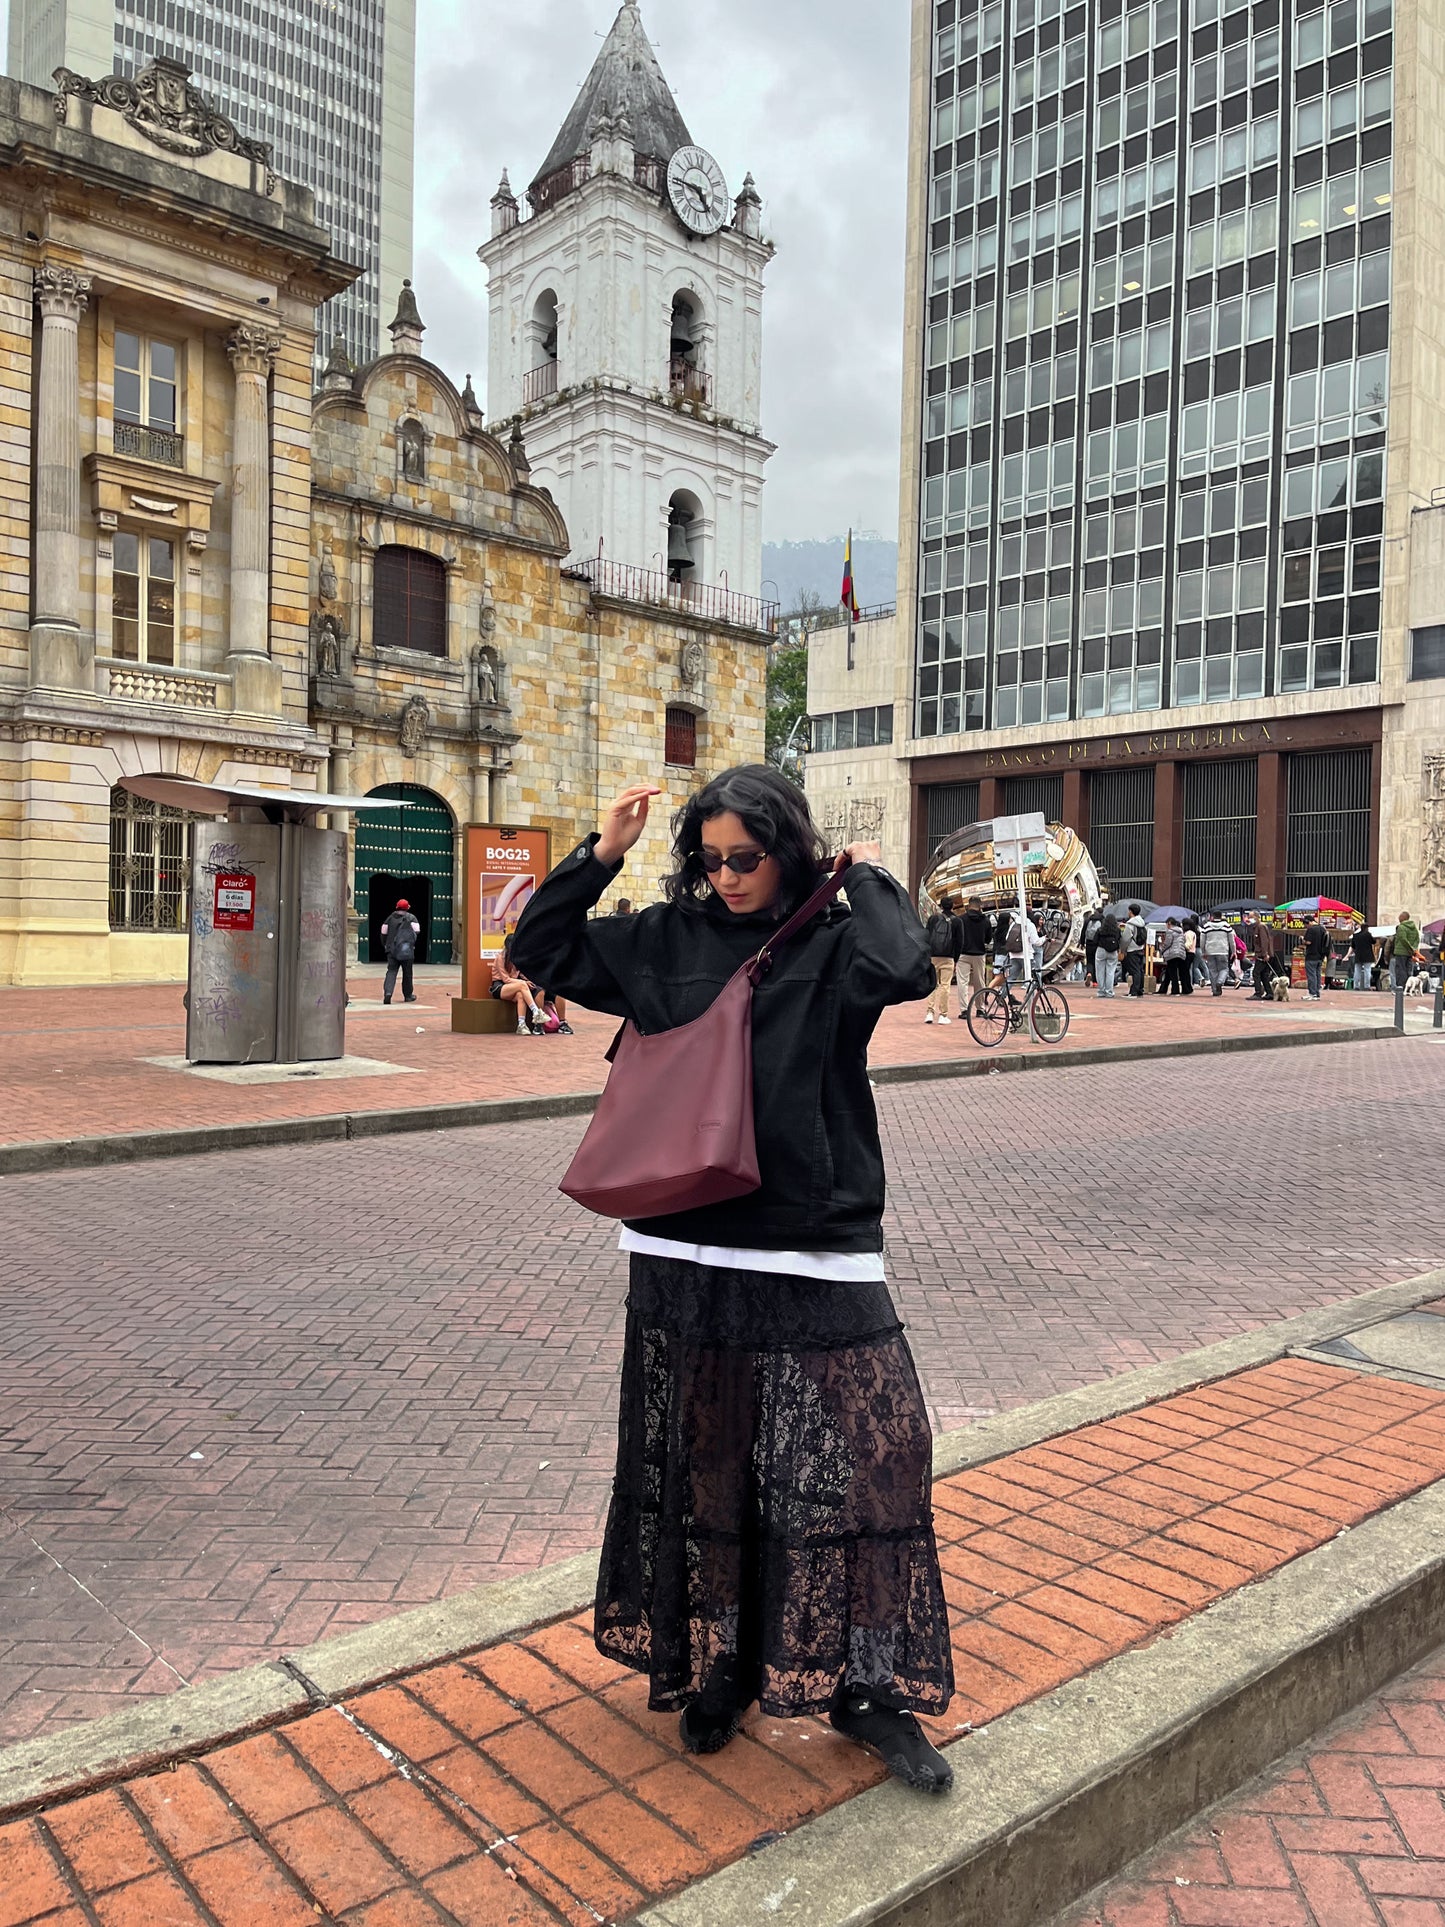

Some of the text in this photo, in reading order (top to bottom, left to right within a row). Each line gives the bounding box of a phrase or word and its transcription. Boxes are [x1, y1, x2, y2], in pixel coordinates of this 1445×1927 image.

[985, 725, 1271, 768] BANCO DE LA REPUBLICA
[486, 847, 531, 861] BOG25
[222, 879, 244, 888] Claro
